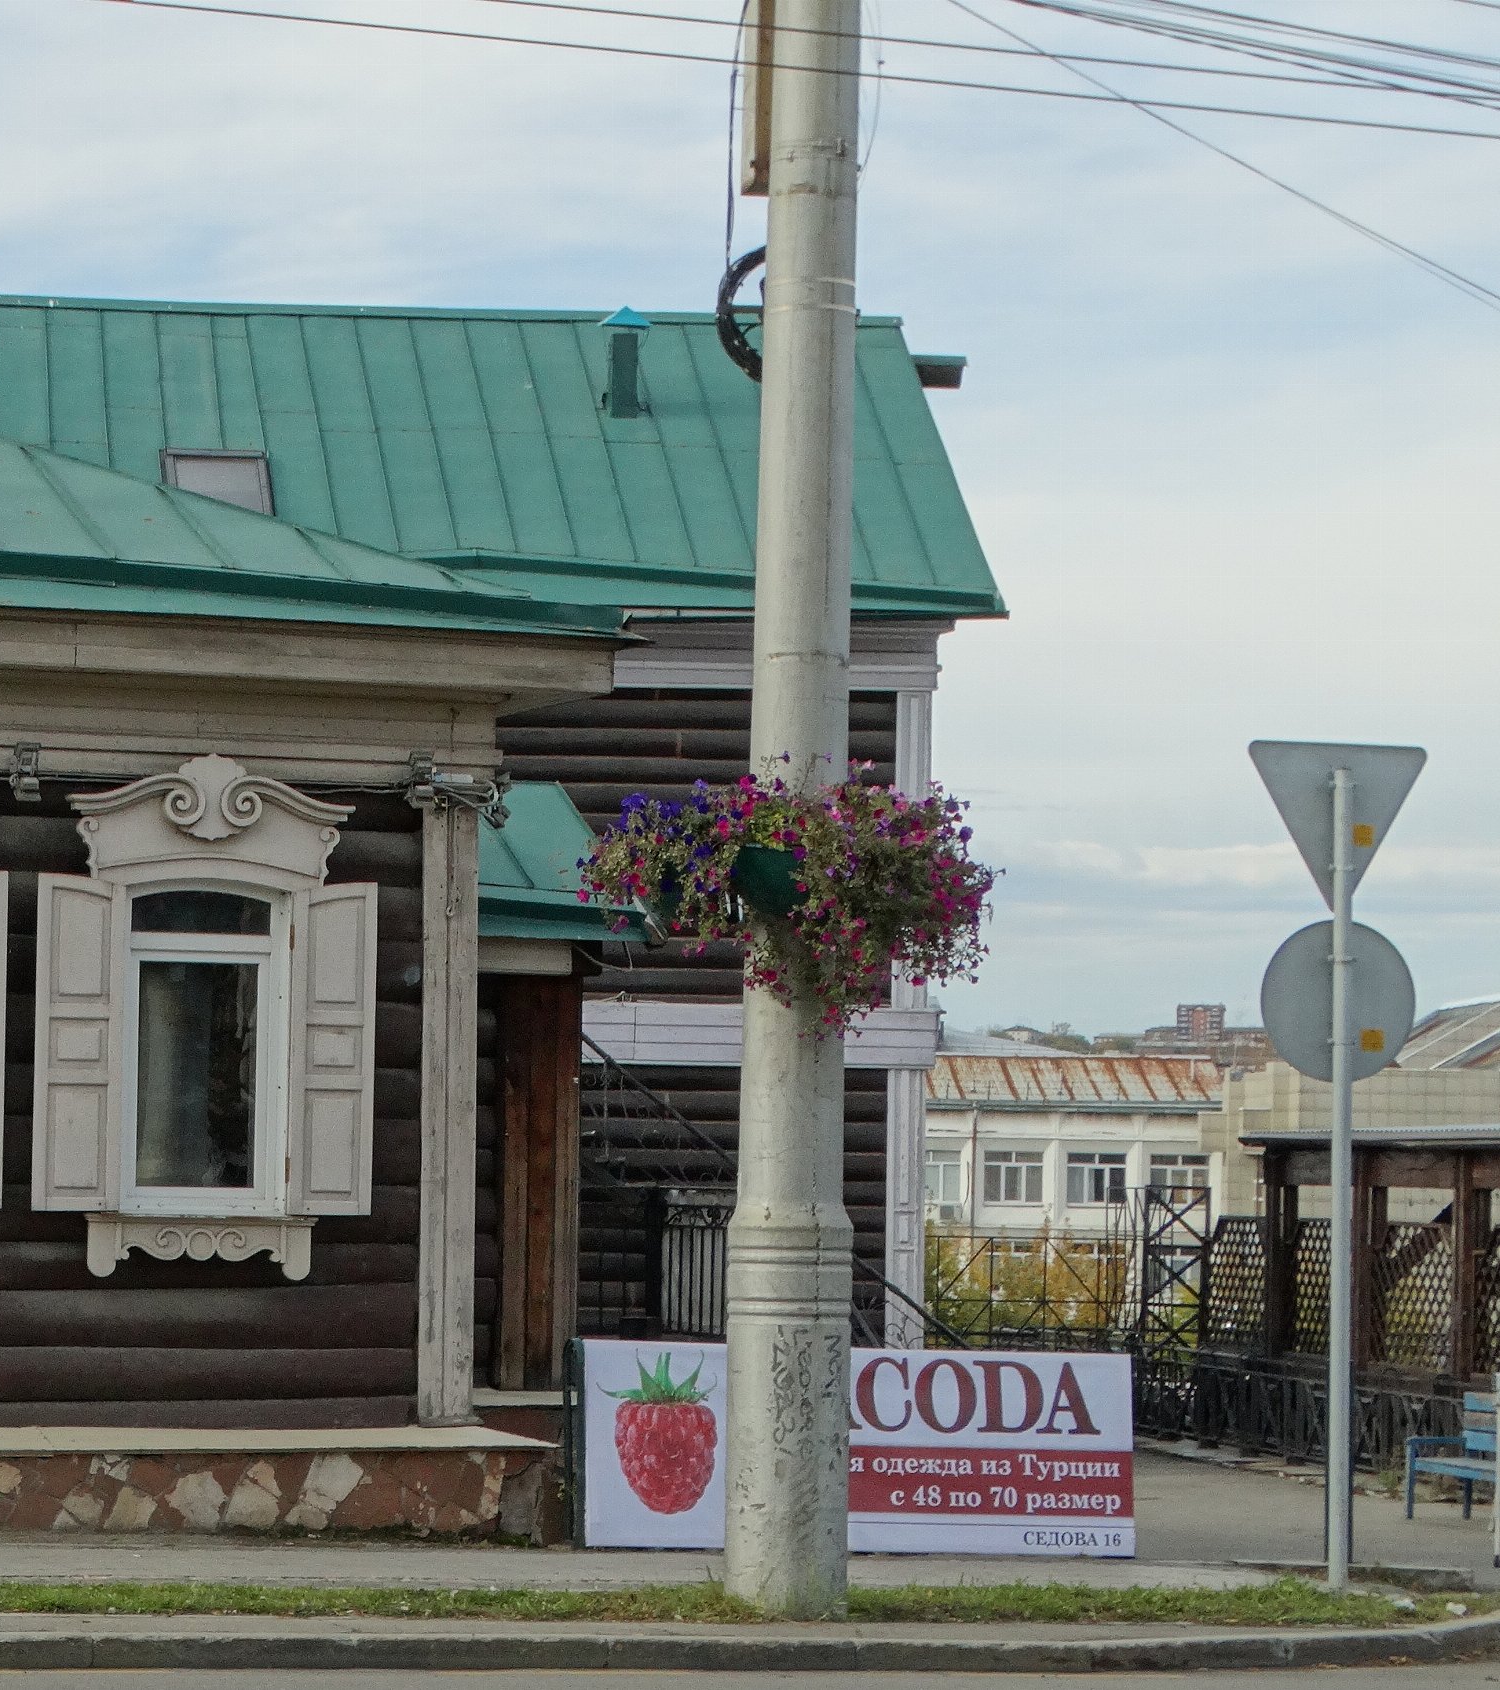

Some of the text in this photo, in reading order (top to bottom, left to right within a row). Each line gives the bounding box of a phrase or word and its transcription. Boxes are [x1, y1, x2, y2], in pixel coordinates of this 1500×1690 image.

[850, 1356, 1102, 1435] CODA
[872, 1456, 974, 1477] одежда
[981, 1459, 1012, 1475] из
[1018, 1453, 1121, 1481] Турции
[890, 1485, 1122, 1515] с 48 по 70 размер
[1023, 1530, 1122, 1548] СЕДОВА 16
